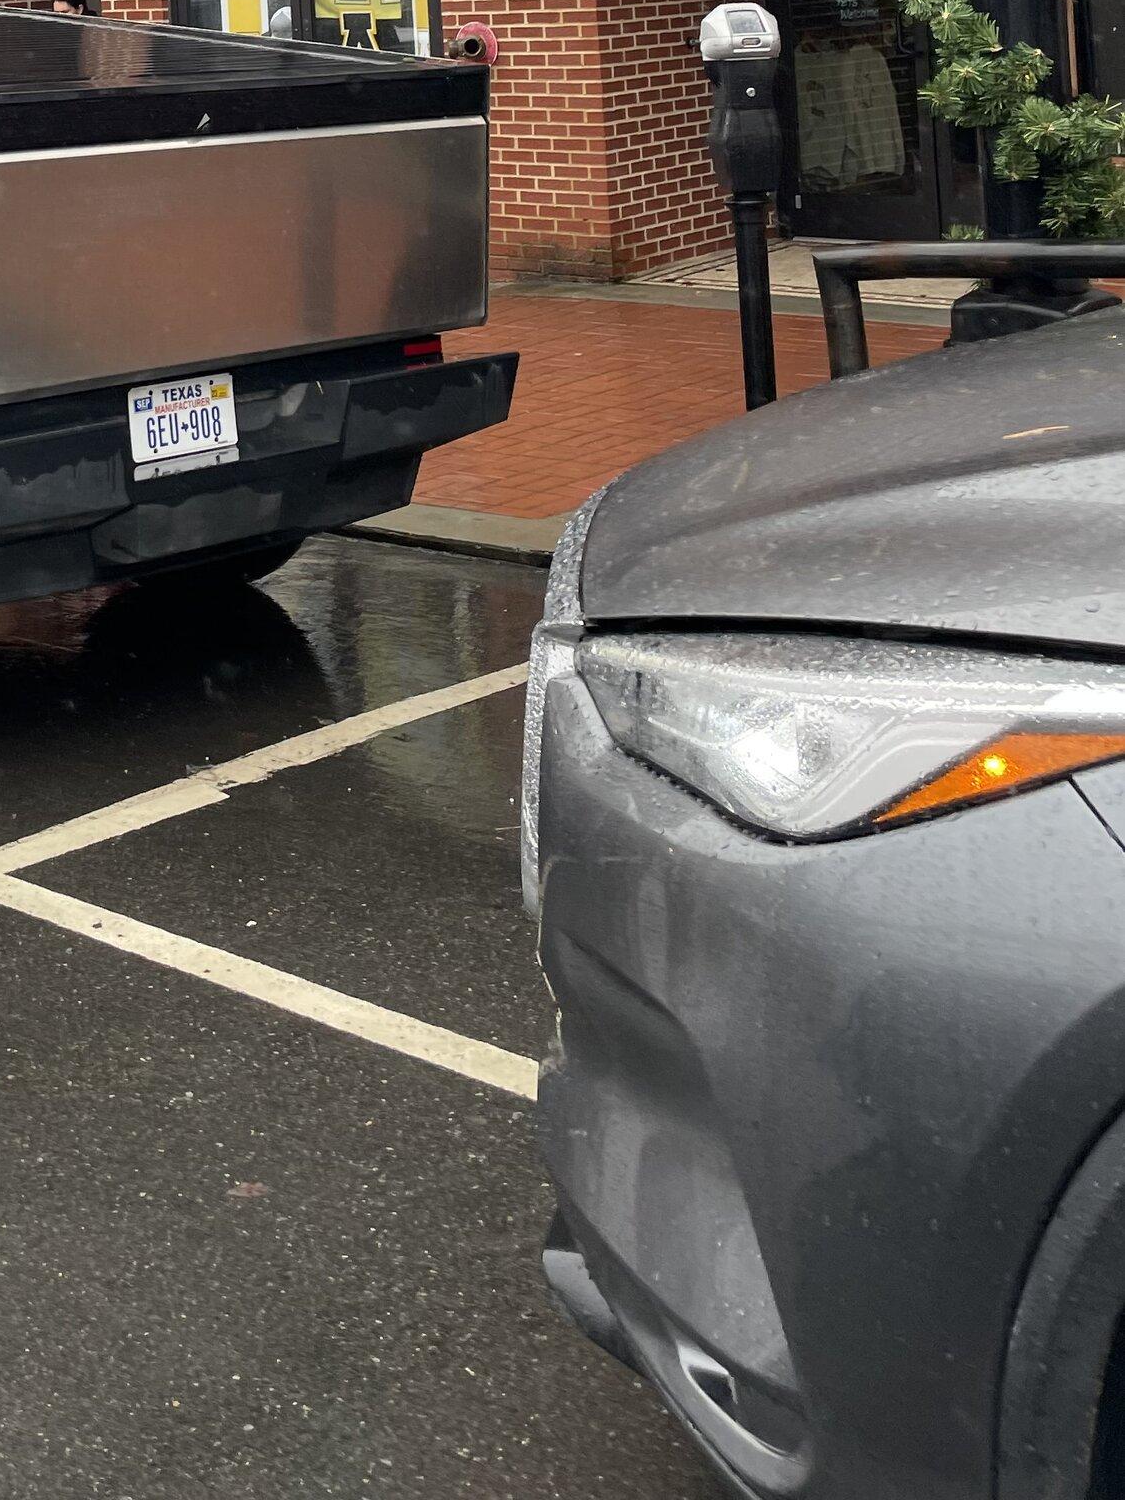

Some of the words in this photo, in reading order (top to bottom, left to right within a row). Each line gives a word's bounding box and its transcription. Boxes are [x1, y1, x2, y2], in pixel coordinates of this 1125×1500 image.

[162, 384, 203, 402] TEXAS
[136, 398, 151, 410] SEP
[155, 397, 211, 415] MANUFACTURER
